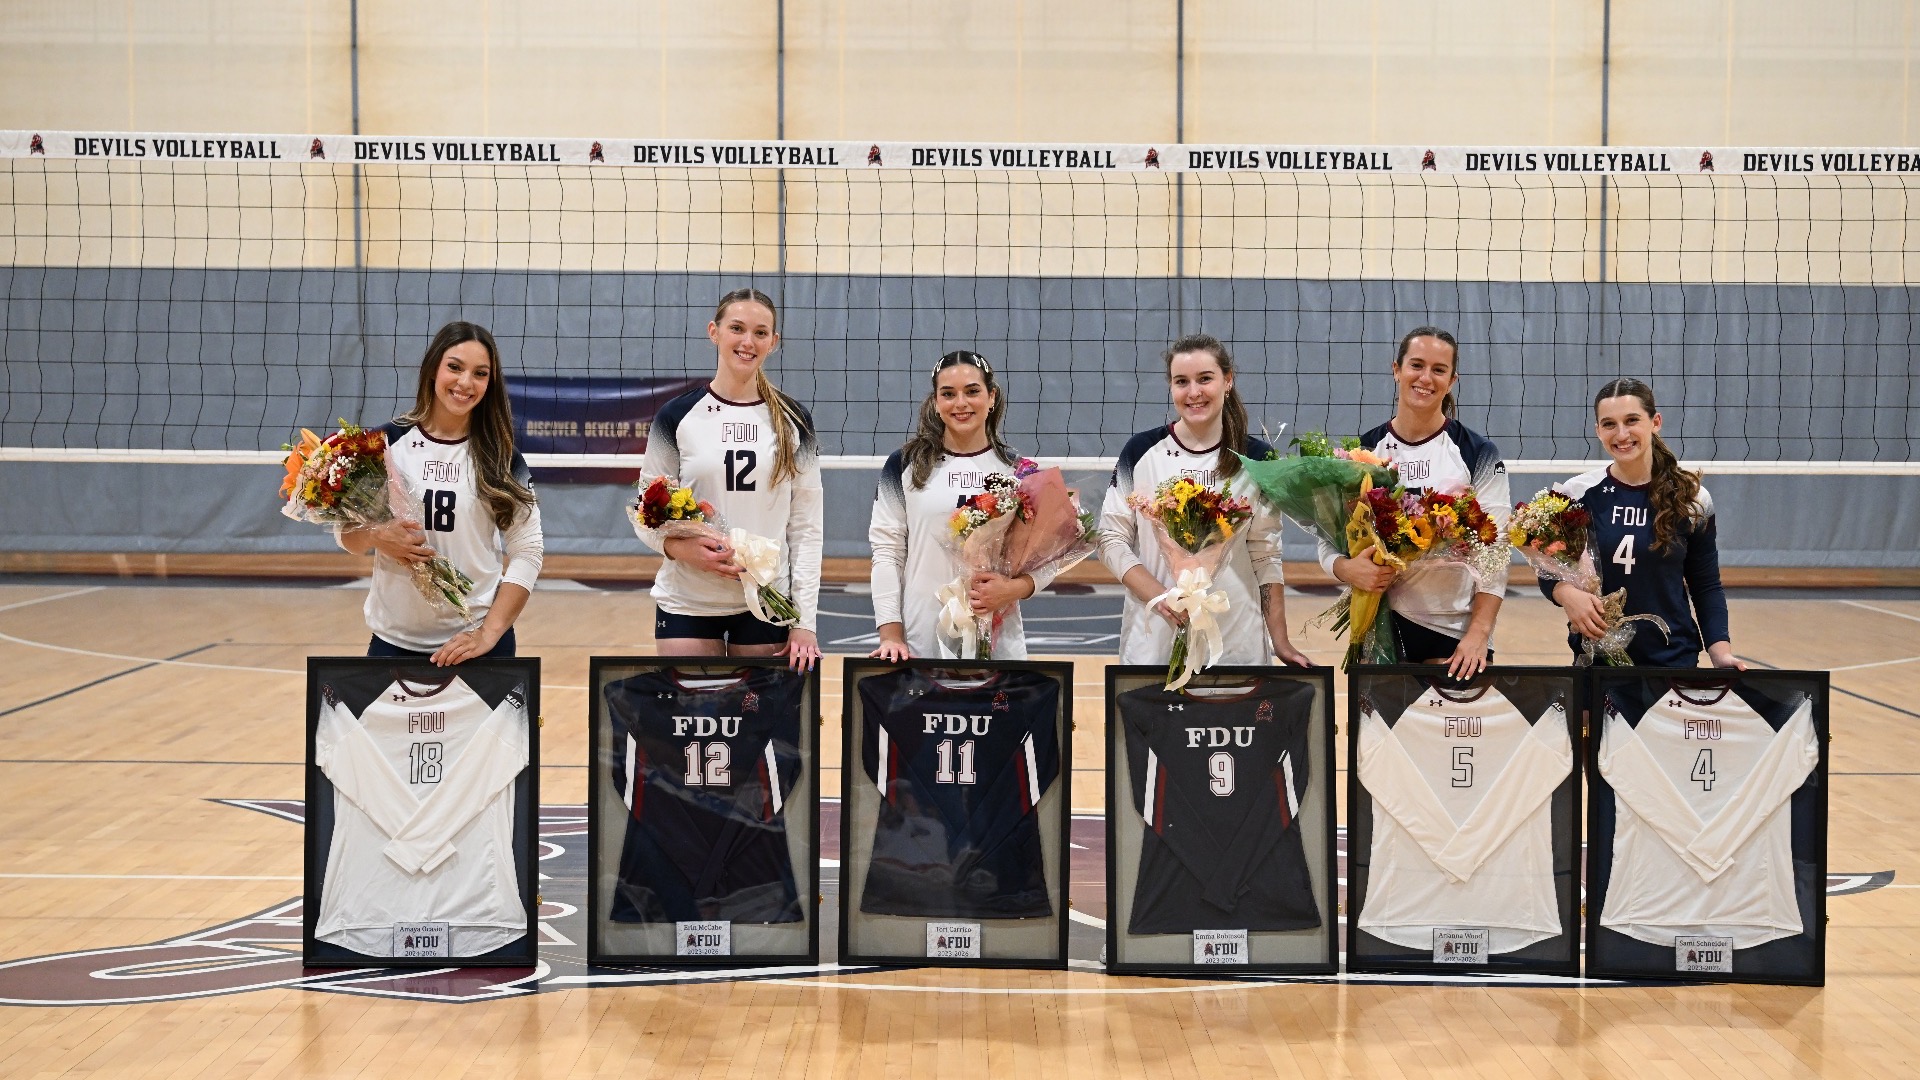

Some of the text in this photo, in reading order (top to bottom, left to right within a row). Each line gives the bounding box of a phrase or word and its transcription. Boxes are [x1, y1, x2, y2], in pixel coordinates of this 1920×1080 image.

[74, 137, 281, 159] DEVILS VOLLEYBALL
[354, 141, 561, 162] DEVILS VOLLEYBALL
[633, 145, 839, 166] DEVILS VOLLEYBALL
[911, 148, 1116, 168] DEVILS VOLLEYBALL
[1188, 150, 1393, 170] DEVILS VOLLEYBALL
[1465, 153, 1671, 172] DEVILS VOLLEYBALL
[1743, 153, 1814, 172] DEVILS
[526, 420, 581, 438] DISCOVER.
[584, 421, 632, 438] DEVELOP.
[722, 422, 758, 444] FDU
[422, 460, 461, 484] FDU
[723, 449, 757, 492] 12
[948, 471, 984, 489] FDU
[422, 488, 457, 532] 18
[1611, 505, 1648, 527] FDU
[1612, 534, 1636, 575] 4
[408, 711, 445, 733] FDU
[671, 715, 743, 738] FDU
[922, 713, 993, 736] FDU
[1444, 716, 1482, 738] FDU
[1683, 718, 1722, 740] FDU
[1184, 726, 1256, 748] FDU
[408, 741, 443, 785] 18
[684, 741, 731, 787] 12
[935, 738, 977, 785] 11
[1451, 746, 1474, 788] 5
[1690, 748, 1716, 792] 4
[1208, 751, 1235, 797] 9
[415, 936, 439, 948] FDU
[697, 934, 721, 947] FDU
[947, 936, 971, 949] FDU
[1214, 942, 1238, 956] FDU
[1454, 942, 1479, 954] FDU
[1697, 950, 1722, 963] FDU
